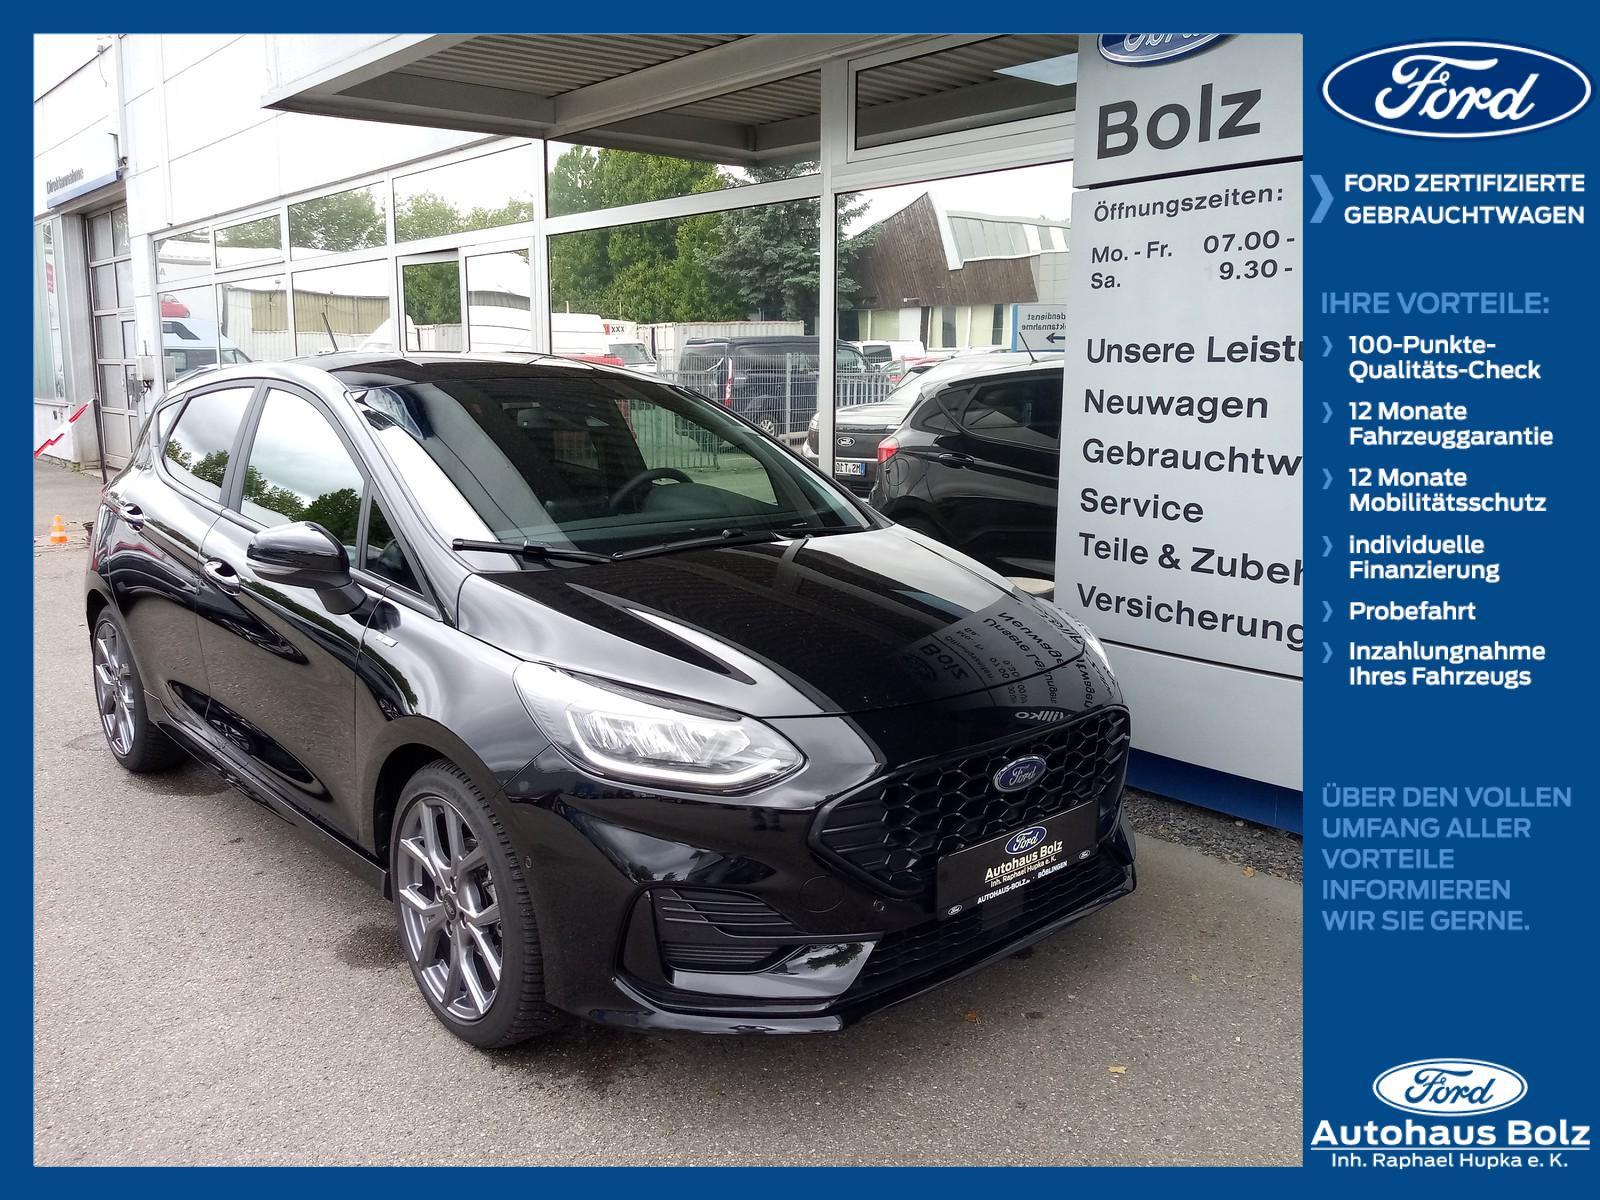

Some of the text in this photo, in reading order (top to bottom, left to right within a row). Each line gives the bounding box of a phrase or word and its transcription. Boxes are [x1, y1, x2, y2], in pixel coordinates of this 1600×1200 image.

[1097, 82, 1262, 160] Bolz
[1093, 187, 1283, 222] Öffnungszeiten:
[1091, 247, 1129, 263] Mo.
[1146, 241, 1173, 259] Fr.
[1203, 230, 1281, 254] 07.00
[1090, 272, 1121, 289] Sa.
[1219, 259, 1278, 280] 9.30
[1087, 335, 1303, 363] Unsere Leist
[1084, 388, 1268, 424] Neuwagen
[1082, 437, 1303, 476] Gebrauchtw
[1080, 487, 1204, 523] Service
[1078, 532, 1149, 565] Teile
[1157, 543, 1182, 570] &
[1076, 583, 1303, 652] Versicherung
[984, 840, 1063, 881] Autohaus Bolz
[1002, 867, 1027, 884] Raphael
[1027, 860, 1045, 874] Hupka
